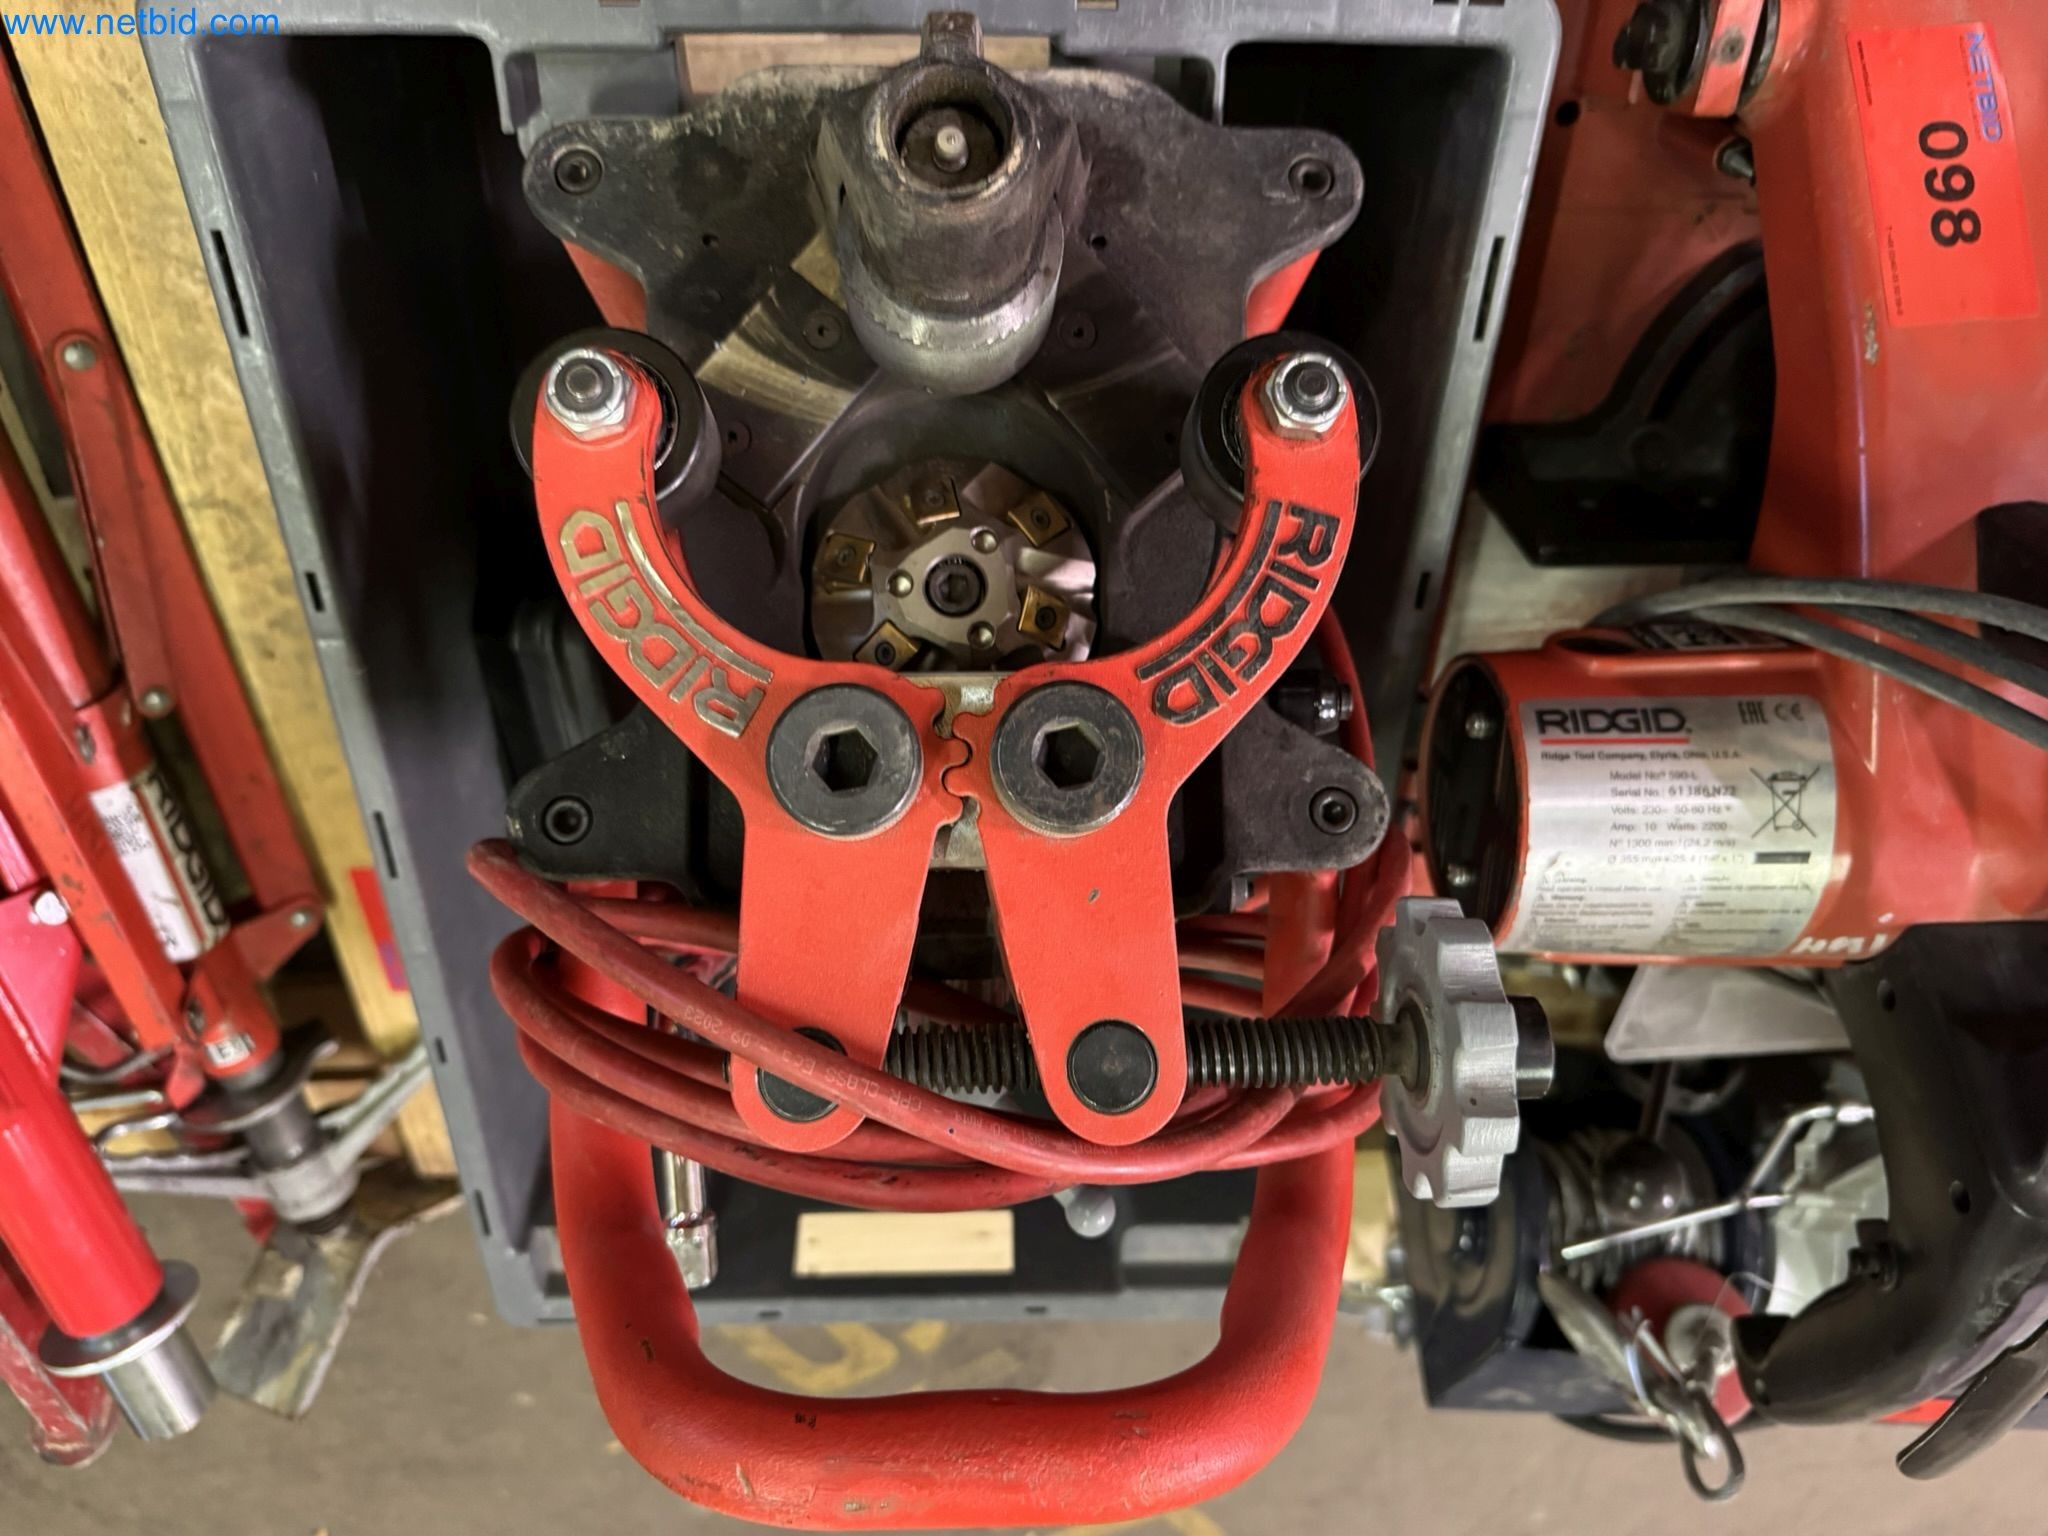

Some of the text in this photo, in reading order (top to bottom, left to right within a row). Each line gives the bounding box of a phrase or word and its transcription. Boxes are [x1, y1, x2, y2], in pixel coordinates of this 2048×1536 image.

[1965, 32, 2003, 142] NETBID
[1918, 121, 1982, 248] 098
[560, 509, 768, 738] RIDGID
[1152, 504, 1341, 725] RIDGID
[1535, 707, 1689, 736] RIDGID
[824, 1067, 881, 1099] CLASS
